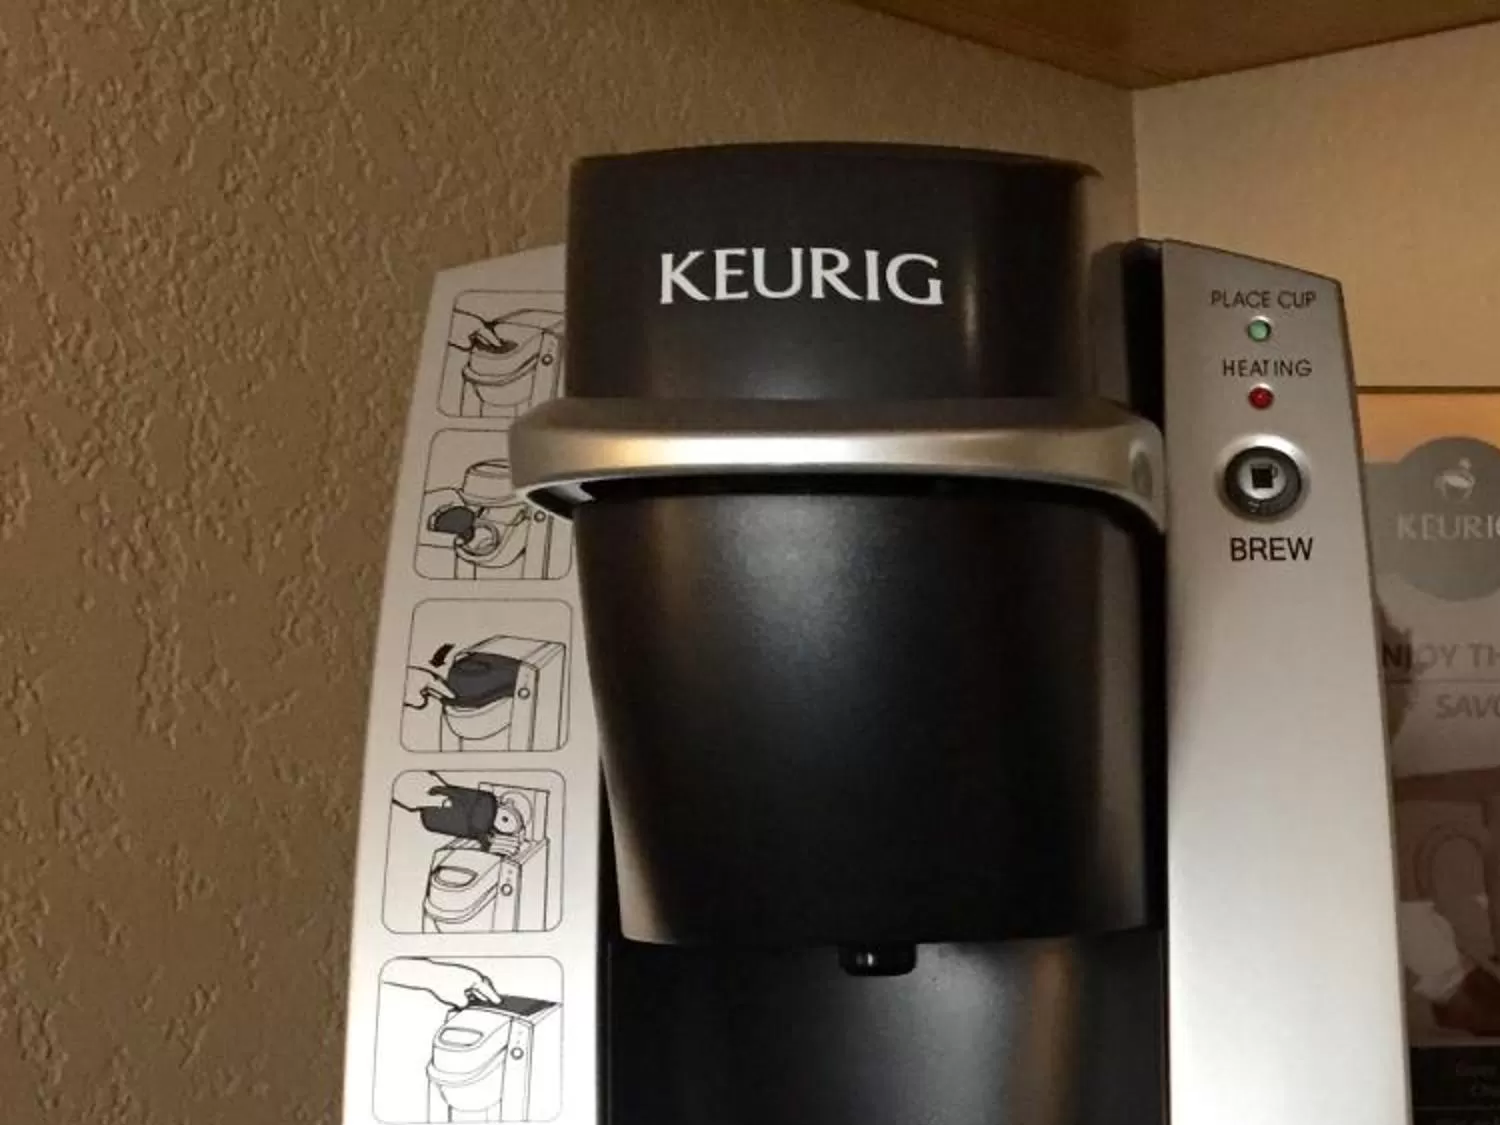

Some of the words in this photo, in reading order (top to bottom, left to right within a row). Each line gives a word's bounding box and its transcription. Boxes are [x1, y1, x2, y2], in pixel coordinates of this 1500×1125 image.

[659, 247, 944, 306] KEURIG
[1210, 290, 1271, 309] PLACE
[1277, 290, 1317, 309] CUP
[1222, 358, 1313, 378] HEATING
[1230, 536, 1314, 562] BREW
[1382, 642, 1457, 672] NJOY
